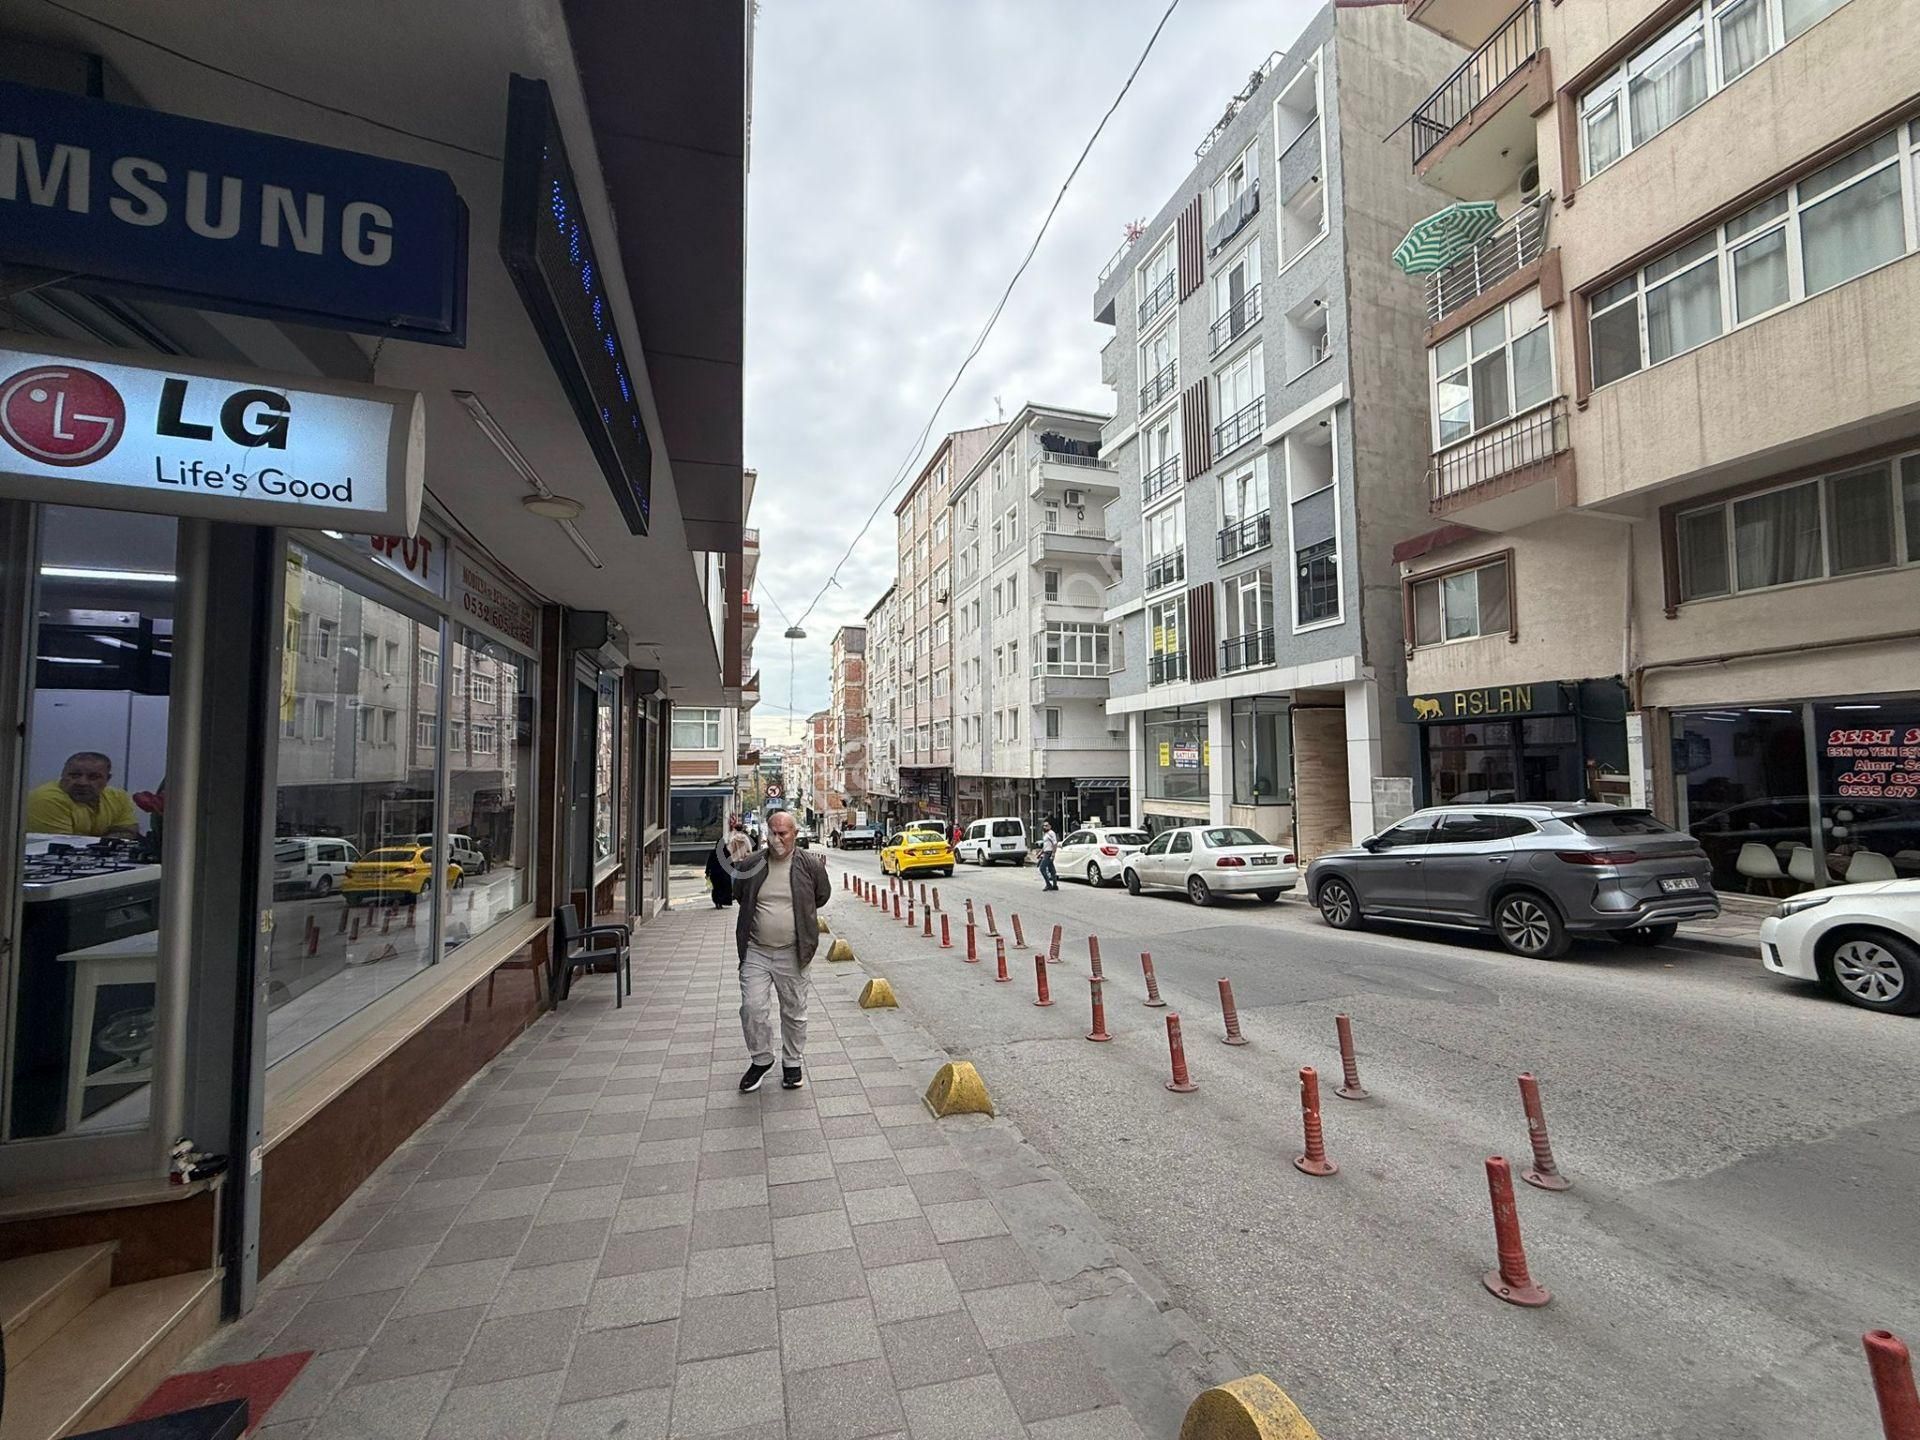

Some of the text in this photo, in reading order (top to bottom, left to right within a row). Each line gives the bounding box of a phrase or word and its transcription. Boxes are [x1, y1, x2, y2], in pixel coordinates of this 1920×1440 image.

[156, 378, 292, 450] LG
[156, 455, 353, 504] Life's Good
[1454, 686, 1532, 717] ASLAN
[1828, 729, 1895, 745] SERT
[1838, 772, 1886, 784] 441
[1839, 785, 1917, 798] 0535 679
